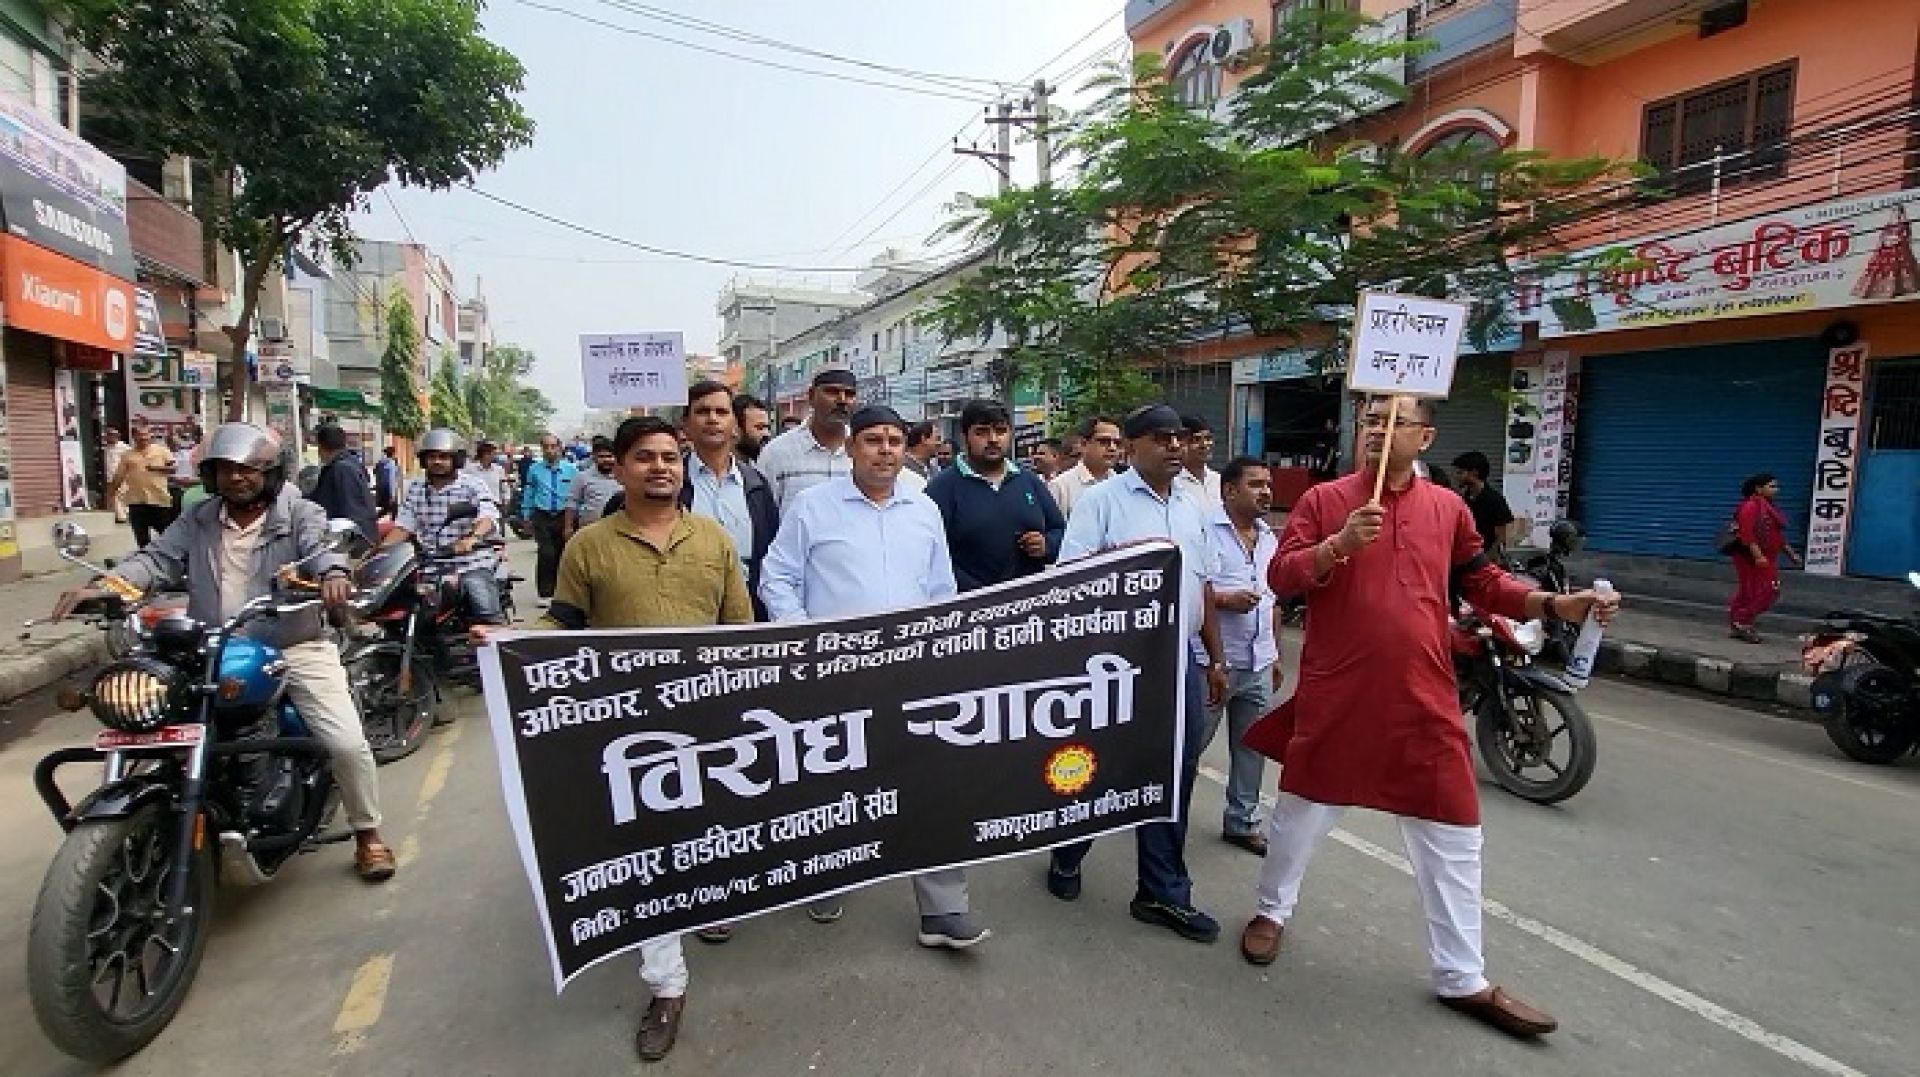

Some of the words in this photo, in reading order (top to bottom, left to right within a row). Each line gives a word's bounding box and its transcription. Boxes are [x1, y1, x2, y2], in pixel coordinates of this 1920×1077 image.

[33, 199, 113, 255] SAMSUNG
[1714, 219, 1855, 290] बुटिक
[22, 272, 80, 316] Xiaomi
[523, 647, 601, 693] प्रहरी
[1124, 569, 1164, 596] हक
[655, 666, 783, 709] स्वाभीमान
[789, 662, 810, 681] र
[816, 640, 928, 680] प्रतिष्ठाको
[931, 624, 988, 658] लागी
[993, 614, 1045, 650] हामी
[1049, 605, 1128, 641] संघर्षमा
[601, 709, 873, 825] विरोध
[560, 846, 666, 902] जनकपुर
[671, 822, 764, 872] हार्डवेयर
[770, 791, 859, 843] व्यवसायी
[864, 786, 898, 821] संघ
[974, 811, 1057, 842] जनकपुरधाम
[766, 859, 798, 887] गते
[802, 840, 884, 875] मंगलवार
